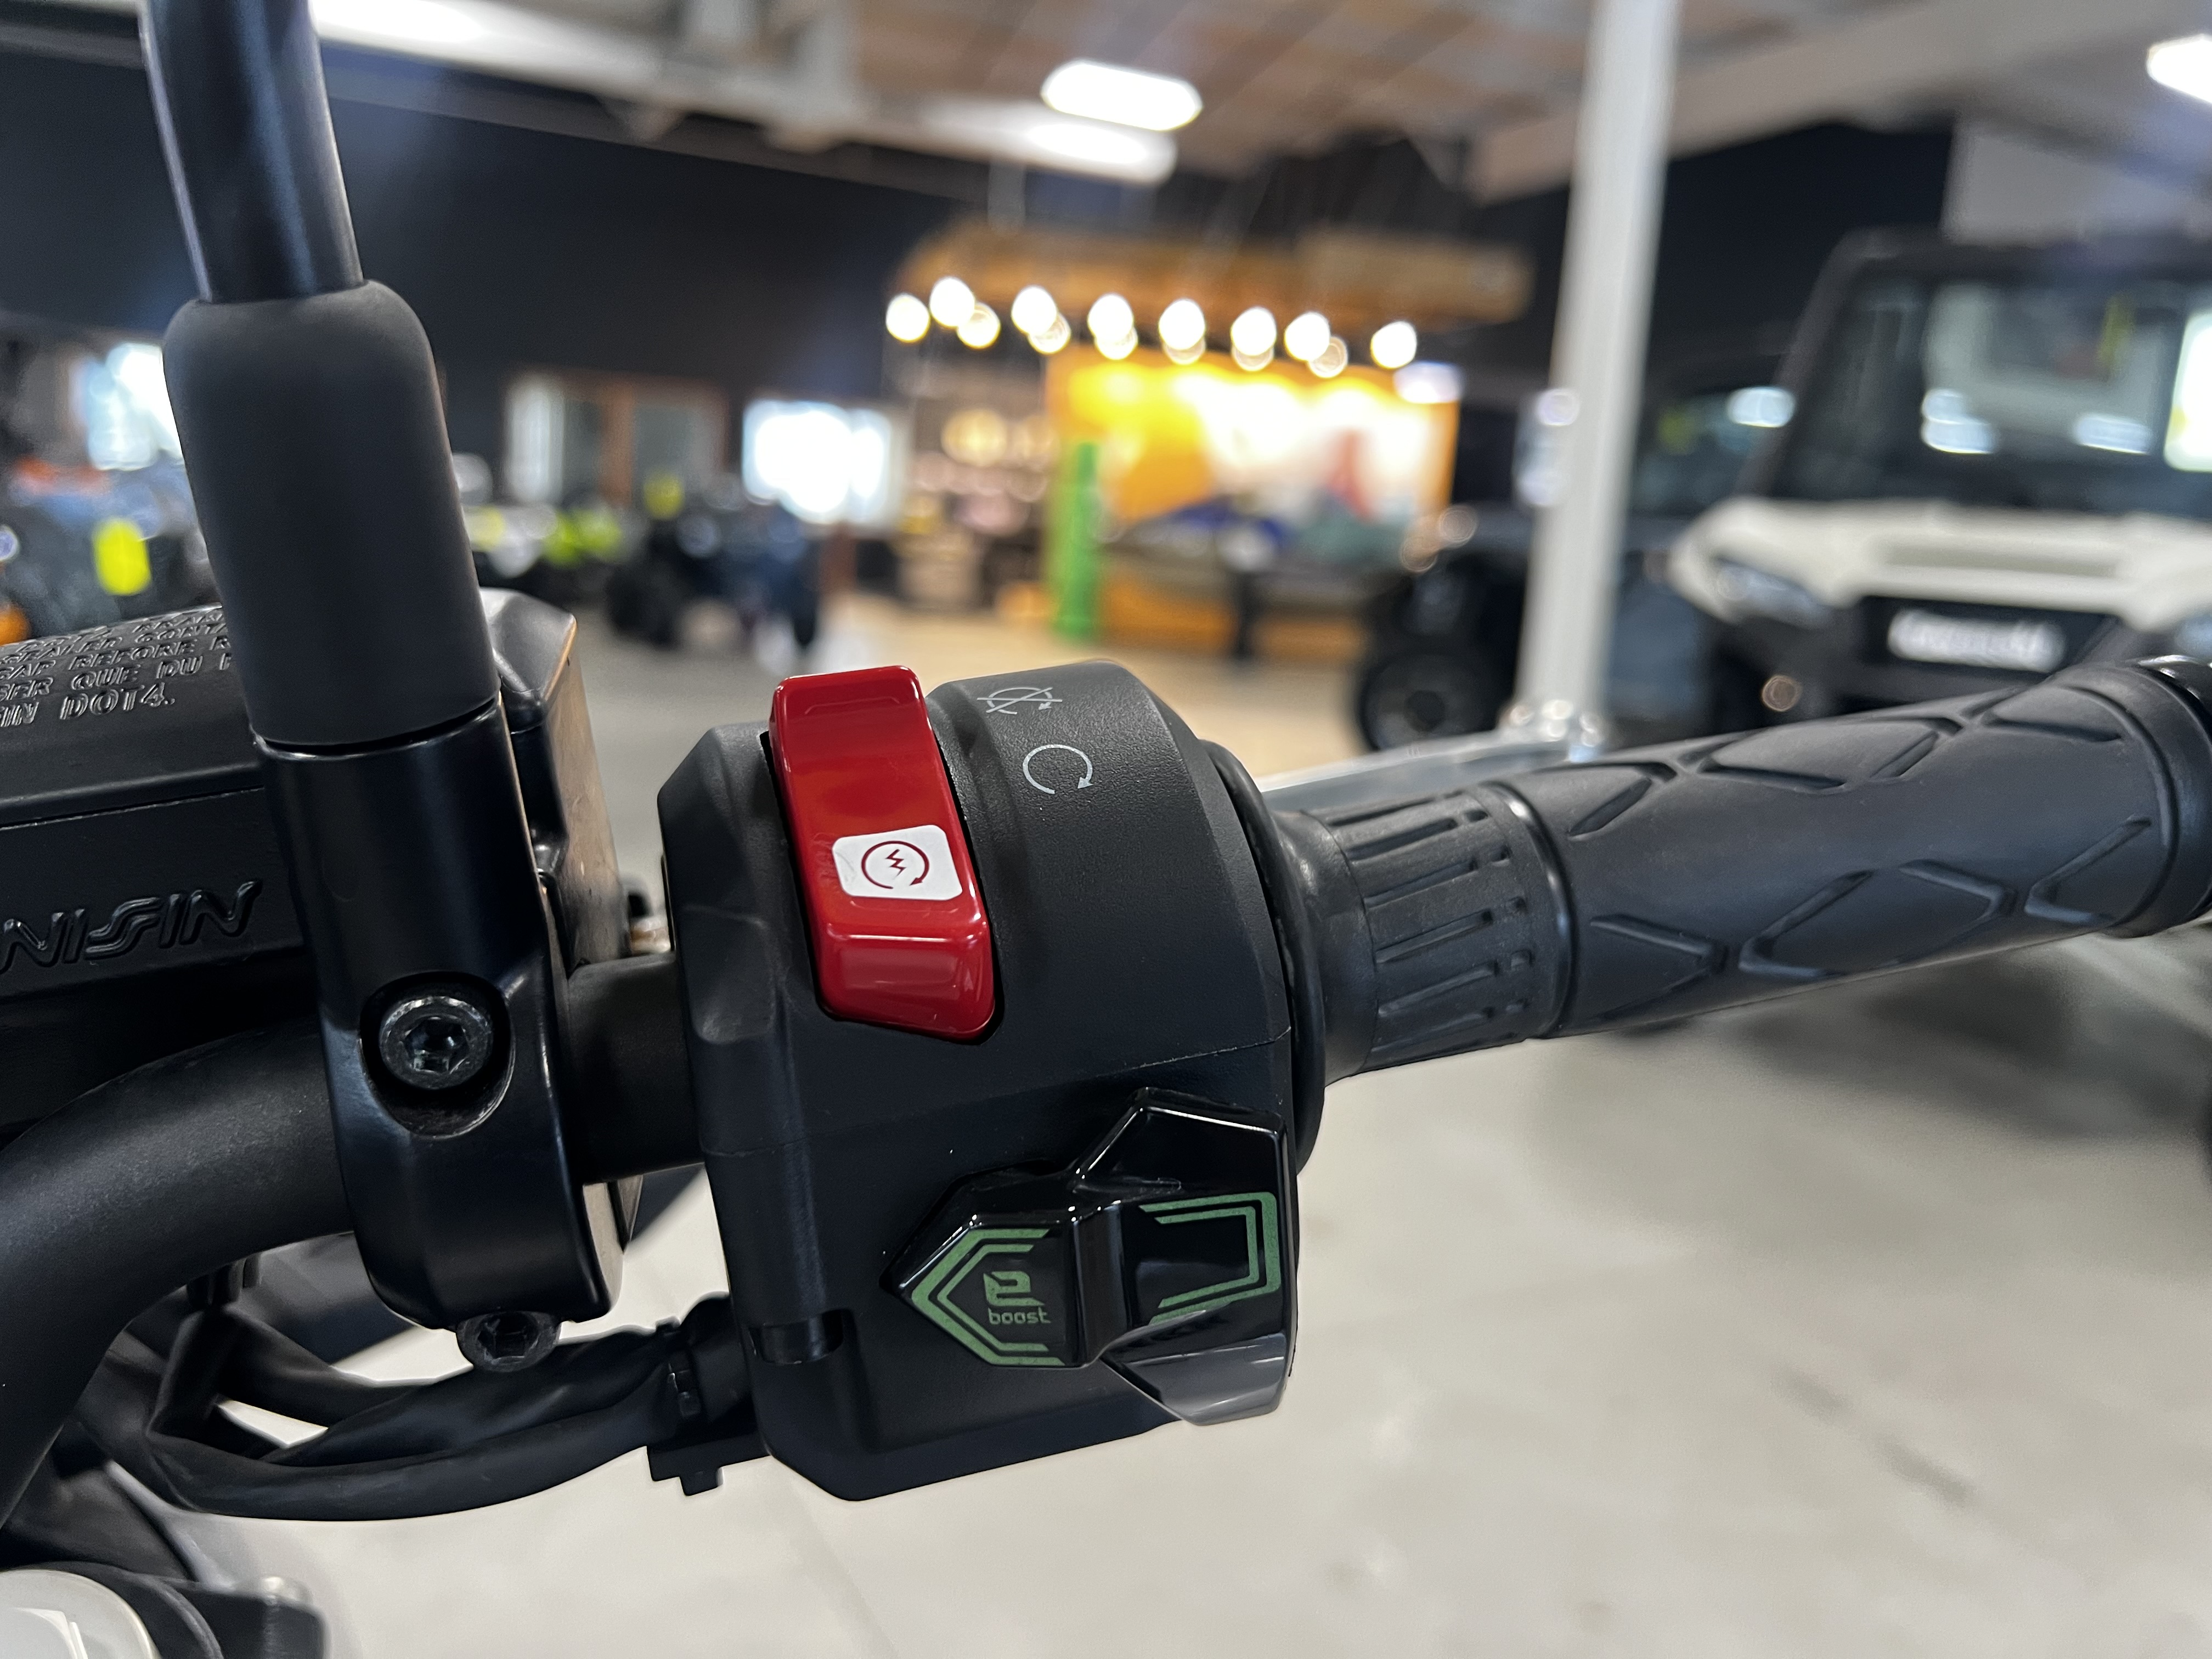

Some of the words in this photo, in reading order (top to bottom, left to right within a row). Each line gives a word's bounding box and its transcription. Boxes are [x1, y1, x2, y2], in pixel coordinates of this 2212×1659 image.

[69, 639, 198, 670] BEFORE
[71, 664, 141, 690] QUE
[156, 656, 203, 679] DU
[988, 1307, 1051, 1325] boost
